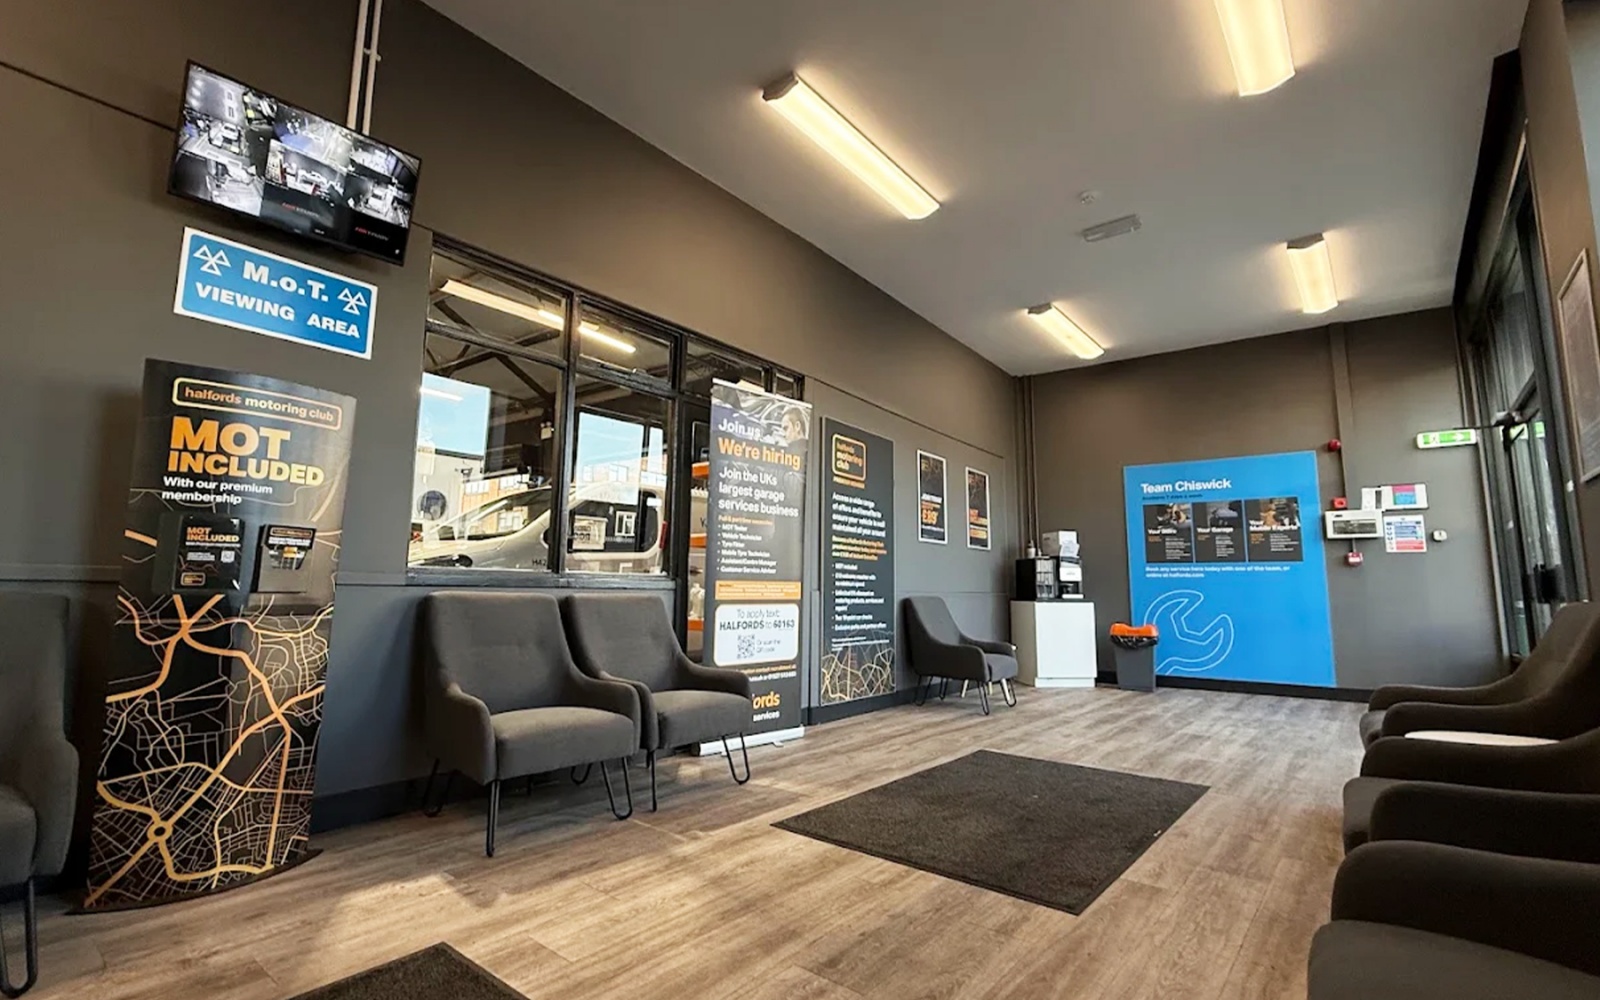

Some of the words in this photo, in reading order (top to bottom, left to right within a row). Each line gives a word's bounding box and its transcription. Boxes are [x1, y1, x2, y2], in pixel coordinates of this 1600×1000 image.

[242, 260, 329, 302] M.o.T.
[195, 282, 295, 321] VIEWING
[307, 313, 360, 338] AREA
[184, 387, 242, 404] halfords
[245, 398, 307, 417] motoring
[309, 408, 334, 422] club
[718, 418, 745, 434] Join
[170, 416, 291, 460] MOT
[718, 437, 760, 460] We're
[762, 446, 801, 471] hiring
[168, 450, 325, 487] INCLUDED
[719, 466, 742, 480] Join
[742, 470, 759, 482] the
[760, 472, 777, 486] UKs
[163, 476, 195, 489] With
[195, 480, 218, 489] our
[220, 482, 273, 495] premium
[718, 482, 753, 498] largest
[754, 488, 785, 502] garage
[1140, 483, 1173, 494] Team
[1174, 478, 1232, 491] Chiswick
[161, 490, 242, 505] membership
[718, 499, 759, 513] services
[761, 502, 799, 517] business
[186, 533, 240, 542] INCLUDED
[187, 527, 212, 535] MOT
[719, 620, 765, 631] HALFORDS
[752, 690, 780, 710] ords
[753, 710, 780, 722] services
